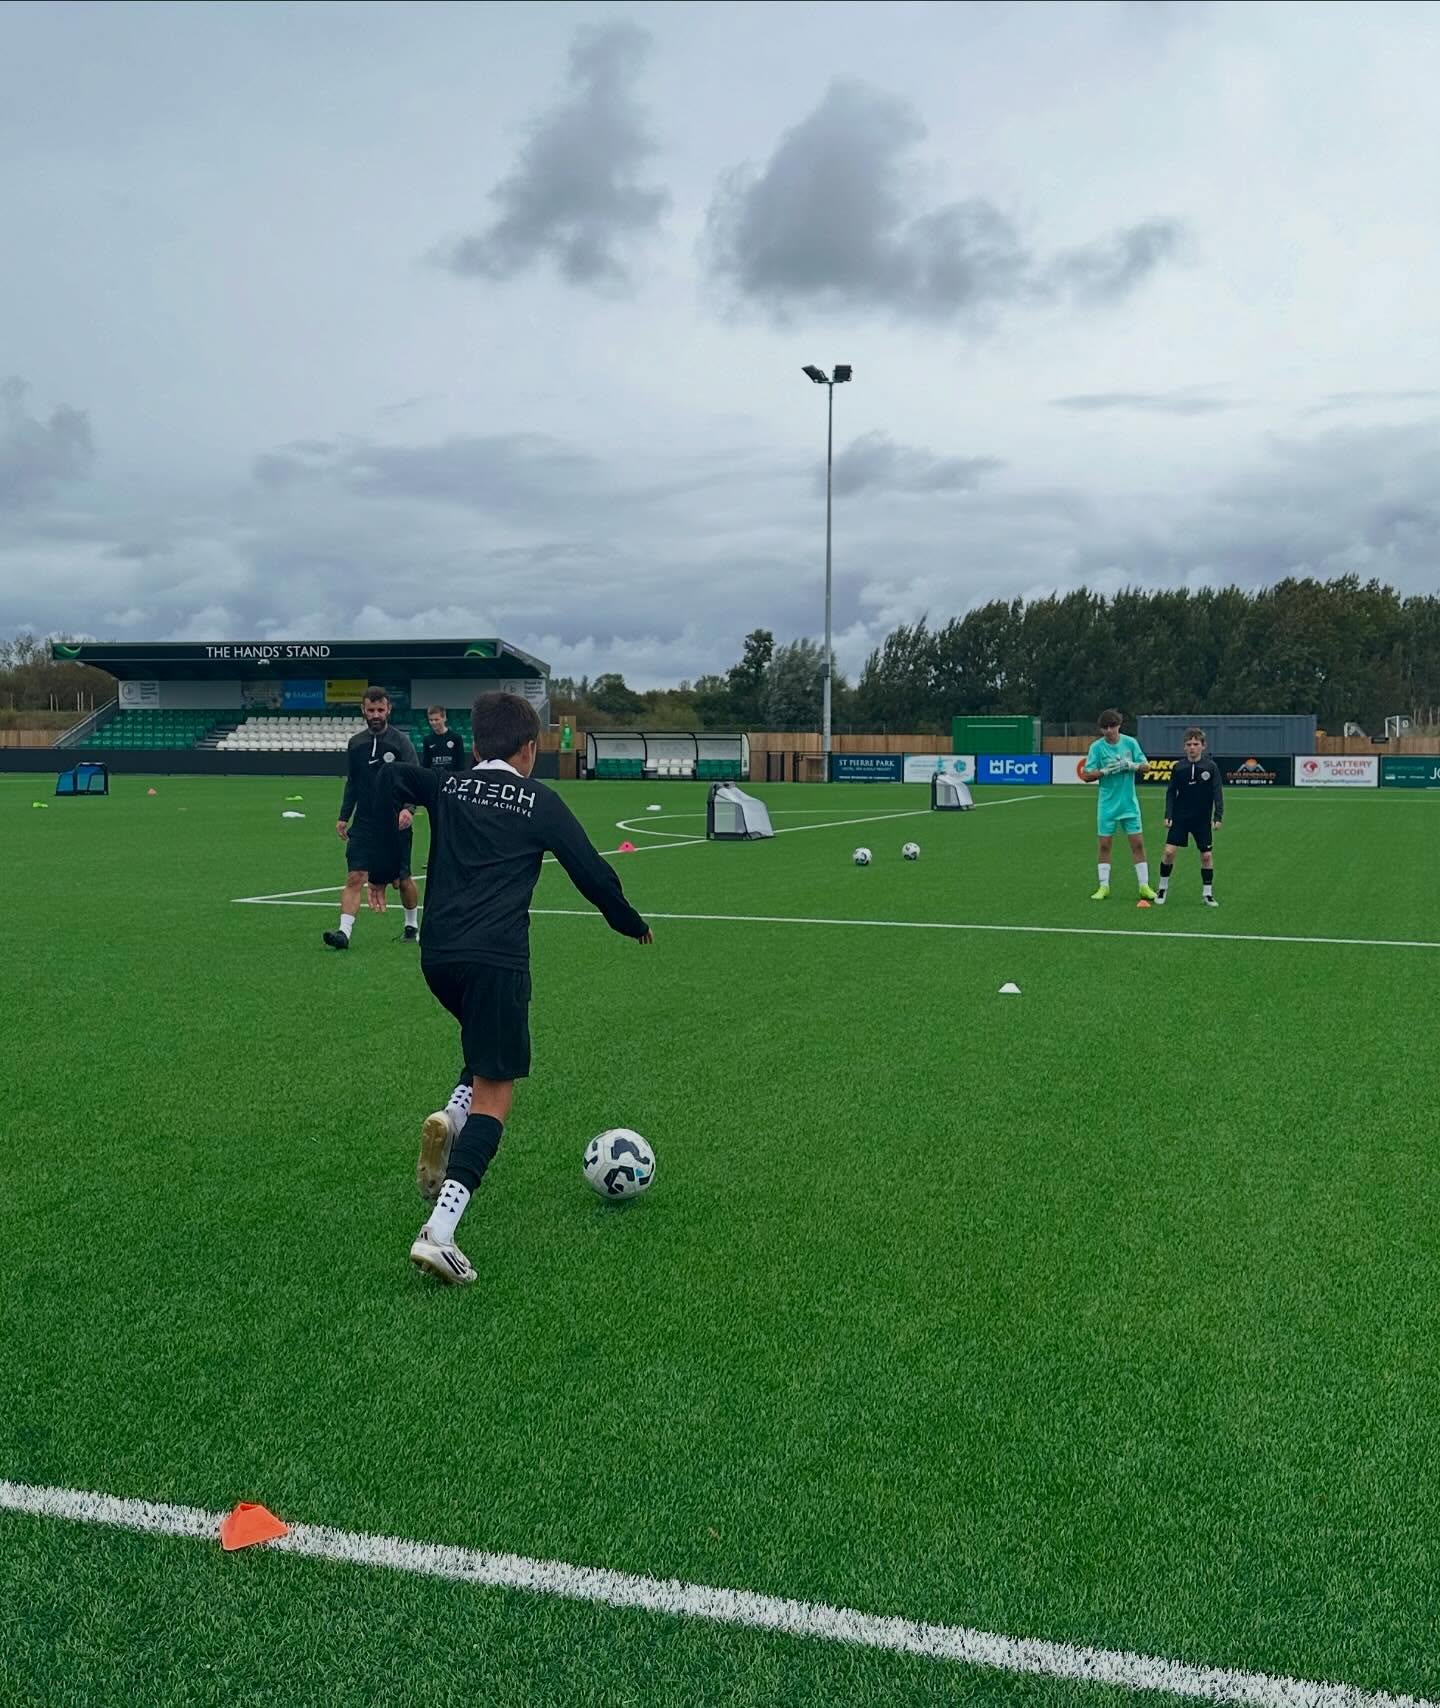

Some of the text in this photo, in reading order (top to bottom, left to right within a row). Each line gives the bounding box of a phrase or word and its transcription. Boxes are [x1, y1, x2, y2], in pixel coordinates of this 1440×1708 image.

[205, 645, 330, 658] THE HANDS' STAND
[1005, 760, 1038, 775] Fort
[1323, 760, 1373, 768] SLATTERY
[1331, 768, 1364, 777] DECOR
[446, 776, 536, 808] AZTECH
